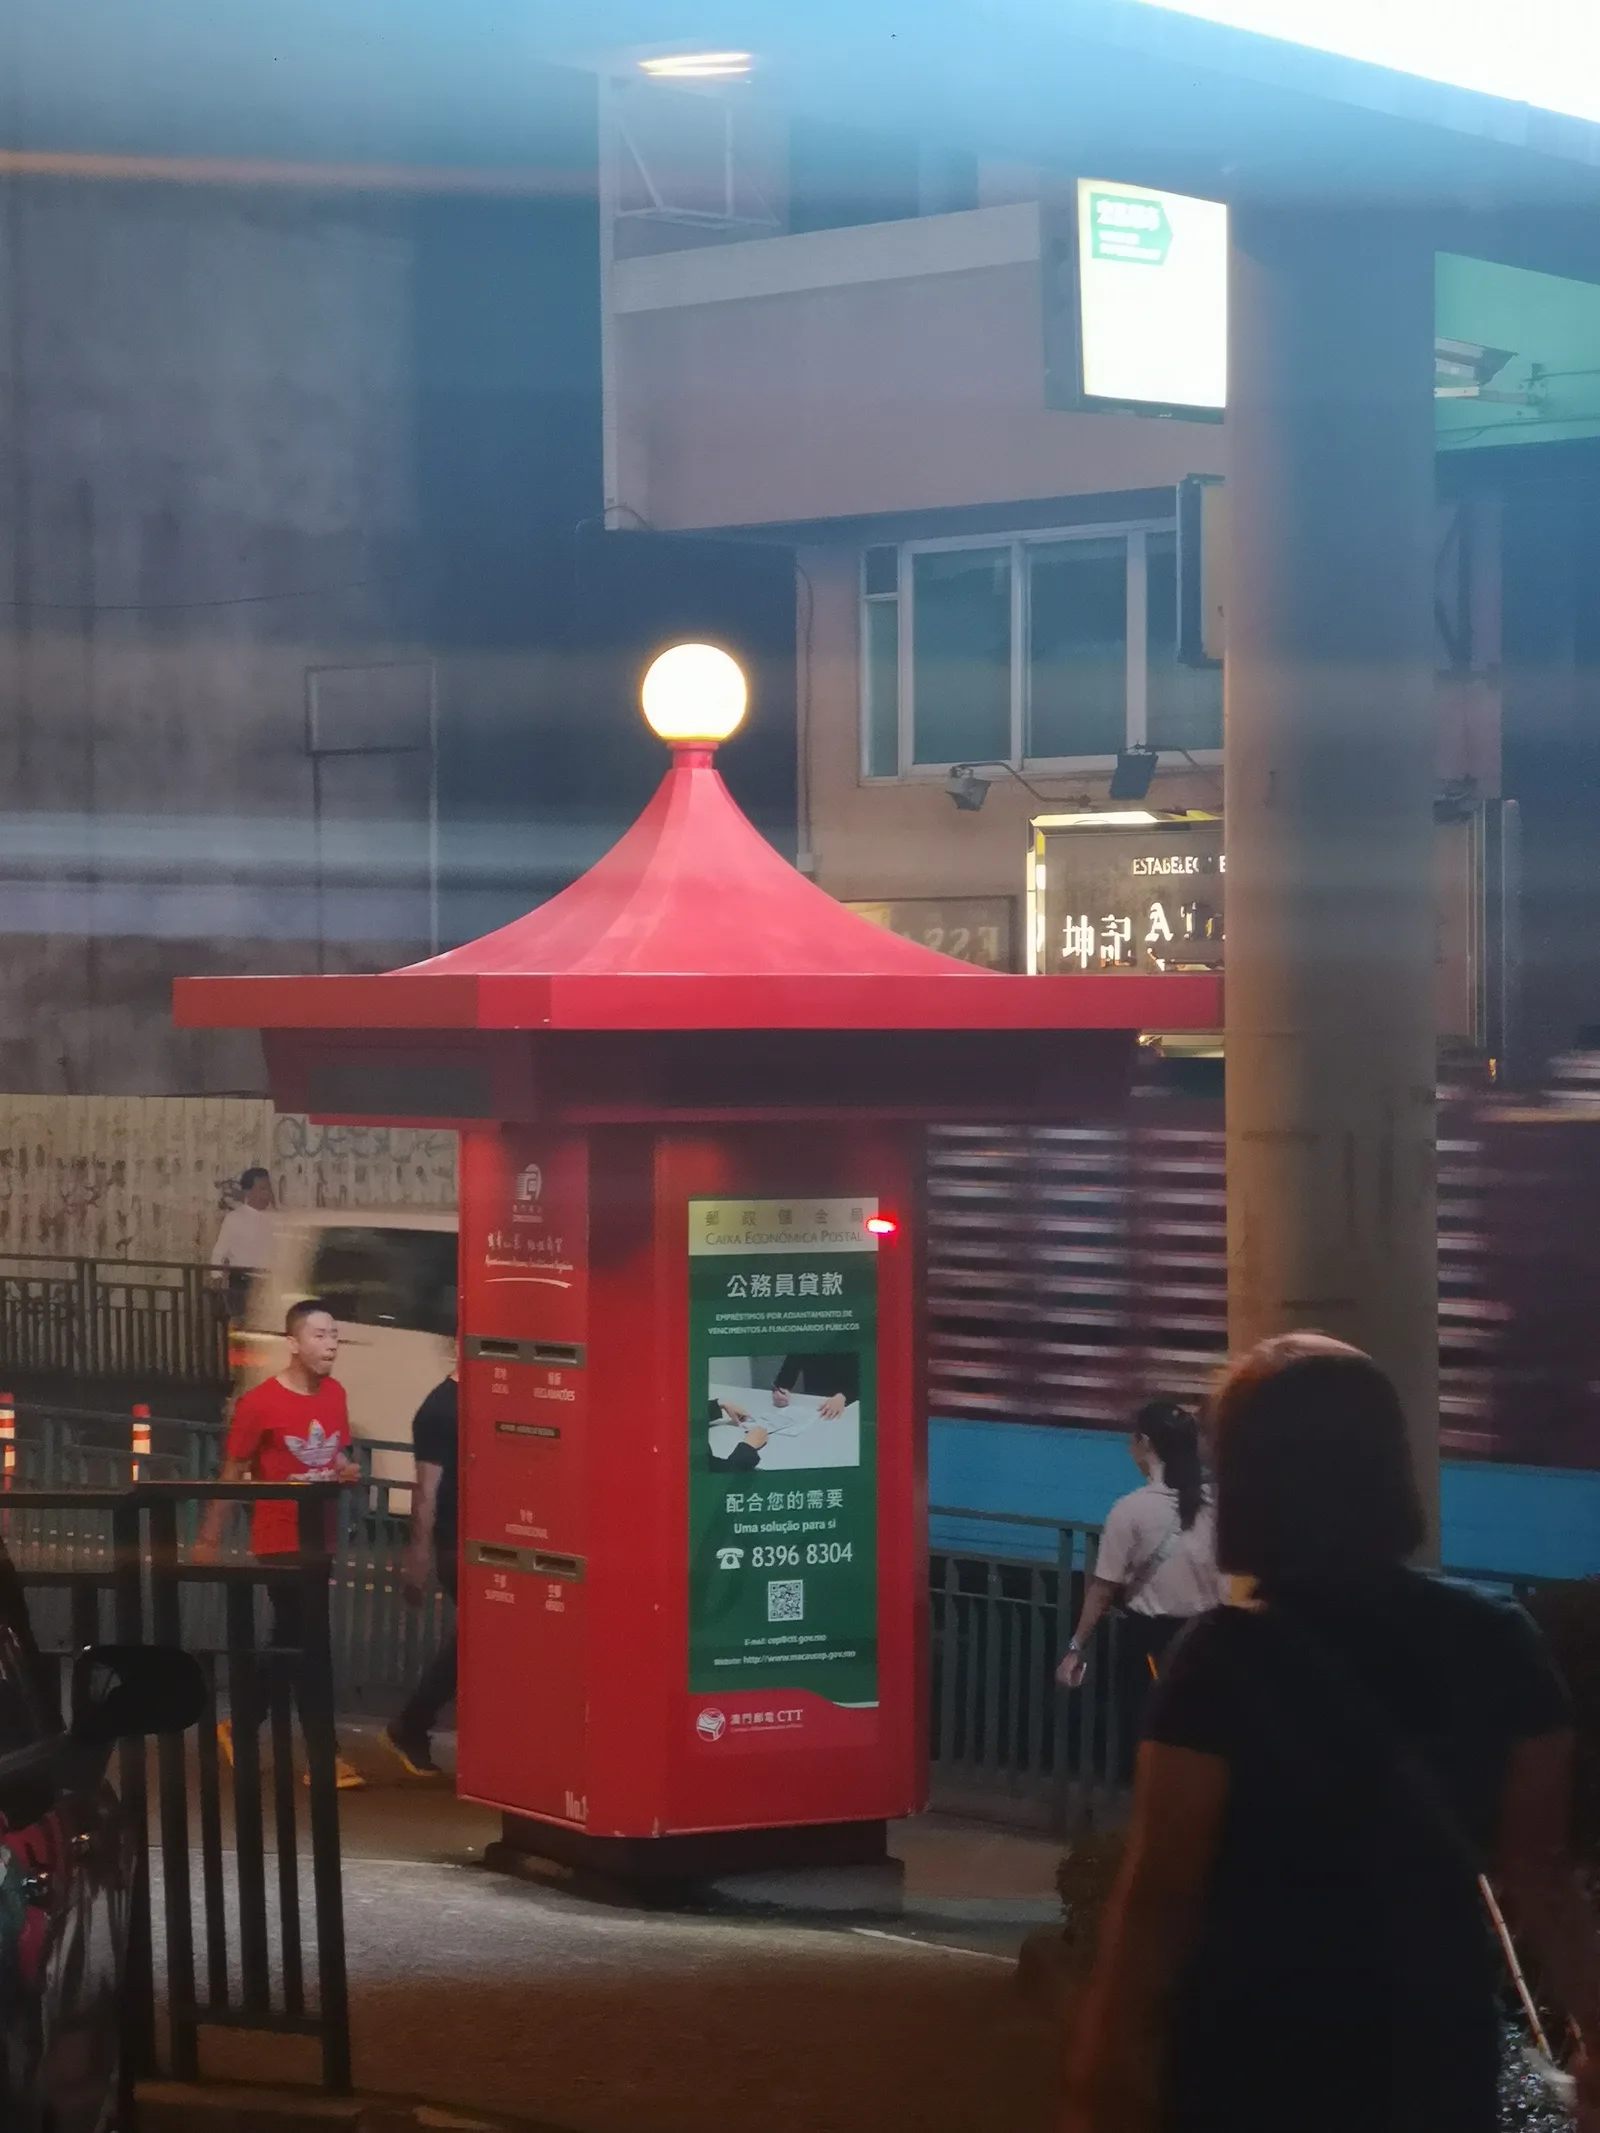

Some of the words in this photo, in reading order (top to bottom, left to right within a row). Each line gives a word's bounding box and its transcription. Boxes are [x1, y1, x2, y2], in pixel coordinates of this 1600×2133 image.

[821, 1229, 864, 1243] POSTAL
[726, 1272, 844, 1298] 公務員貸款
[707, 1325, 761, 1335] VENCIMENTOS
[726, 1488, 844, 1514] 配合您的需要
[733, 1522, 758, 1534] Uma
[760, 1520, 800, 1534] solução
[802, 1520, 826, 1533] para
[751, 1545, 800, 1568] 8396
[806, 1541, 853, 1565] 8304
[777, 1708, 804, 1722] CTT
